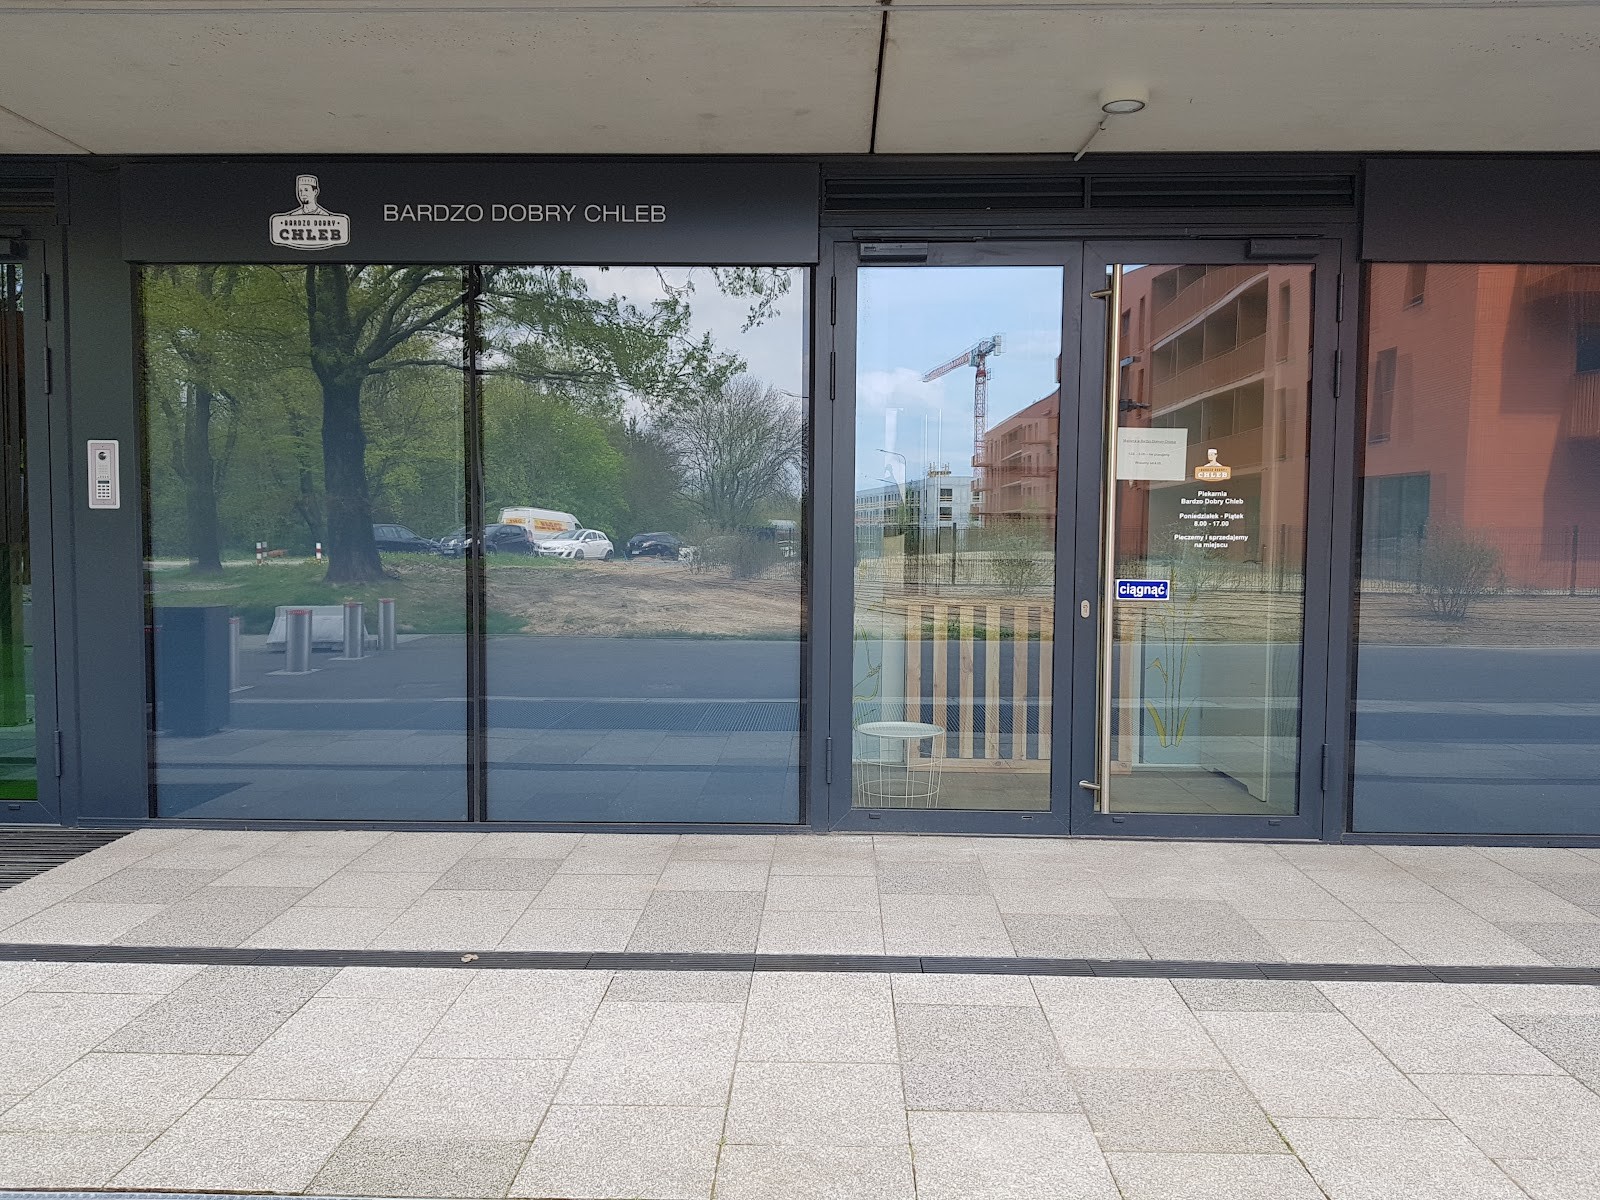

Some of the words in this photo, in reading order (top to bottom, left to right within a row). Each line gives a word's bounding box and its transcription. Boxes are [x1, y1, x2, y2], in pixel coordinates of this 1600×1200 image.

[383, 203, 484, 222] BARDZO
[491, 203, 577, 222] DOBRY
[584, 203, 667, 223] CHLEB
[279, 228, 342, 241] CHLEB
[1204, 498, 1224, 506] Dobry
[1224, 512, 1244, 520] Piątek
[1173, 534, 1204, 542] Pieczemy
[1208, 534, 1249, 542] sprzedajemy
[1119, 583, 1165, 598] ciągnąć
